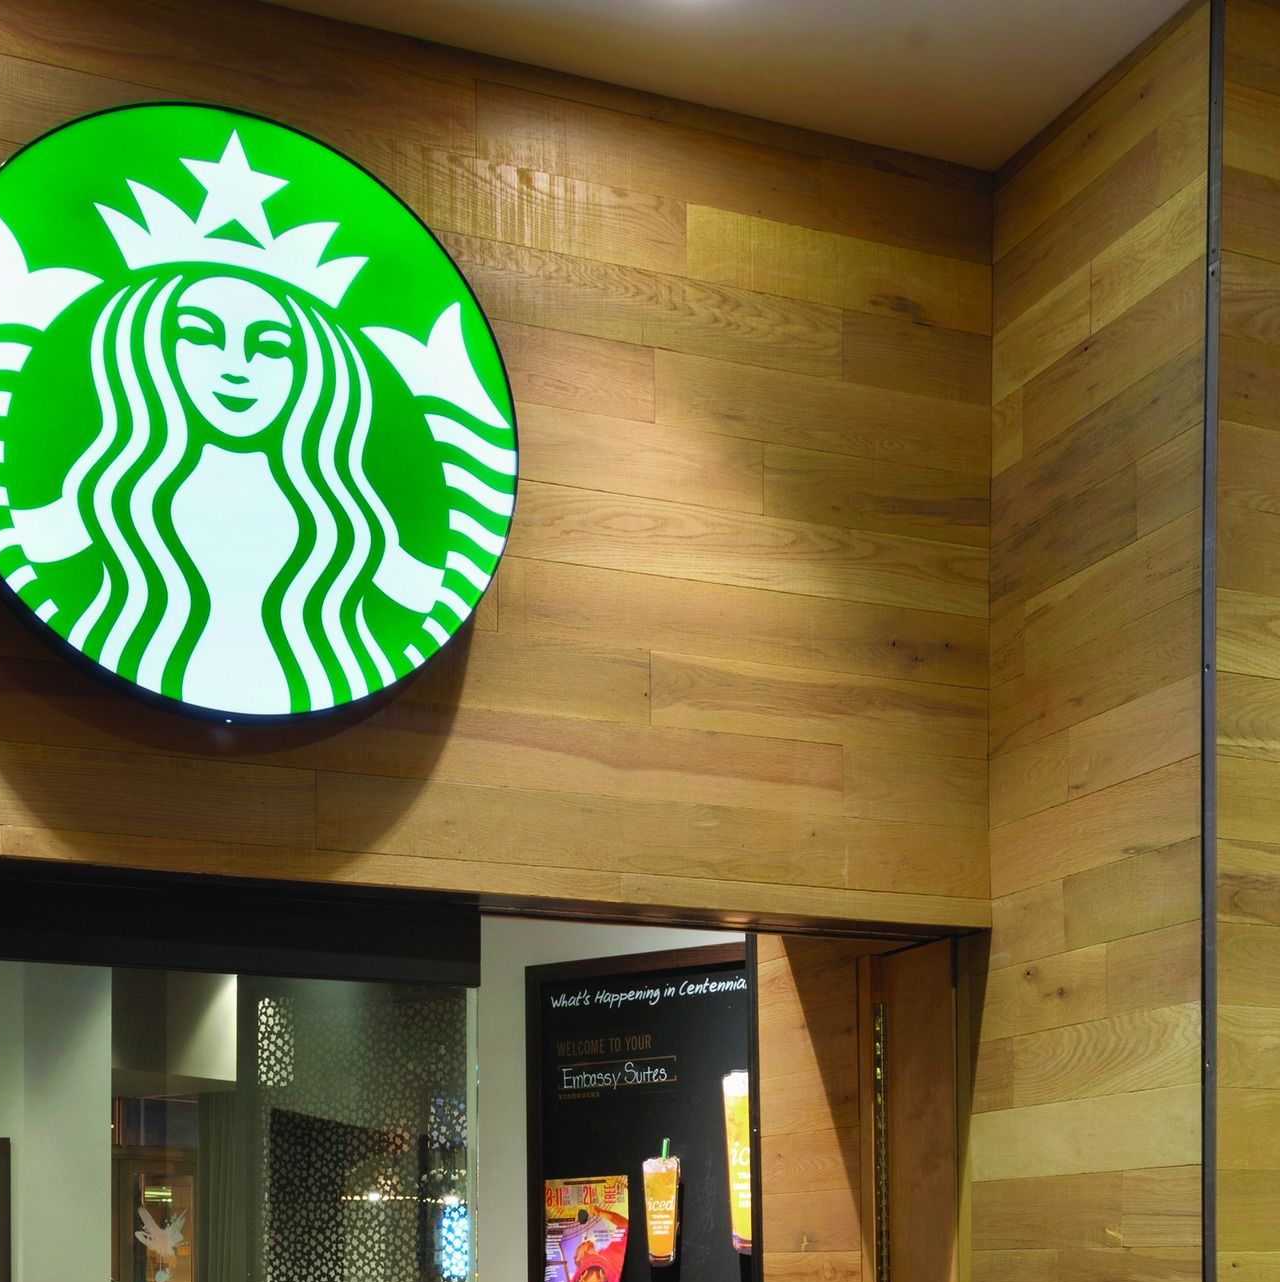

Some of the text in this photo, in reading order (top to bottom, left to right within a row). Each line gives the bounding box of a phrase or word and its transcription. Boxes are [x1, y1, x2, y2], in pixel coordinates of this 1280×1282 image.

[551, 989, 590, 1008] What's
[594, 985, 660, 1008] Happening
[663, 983, 675, 997] in
[557, 1034, 652, 1057] WELCOME TO YOUR
[562, 1062, 668, 1090] Embassy Suites
[730, 1141, 750, 1167] ic
[647, 1195, 675, 1211] iced
